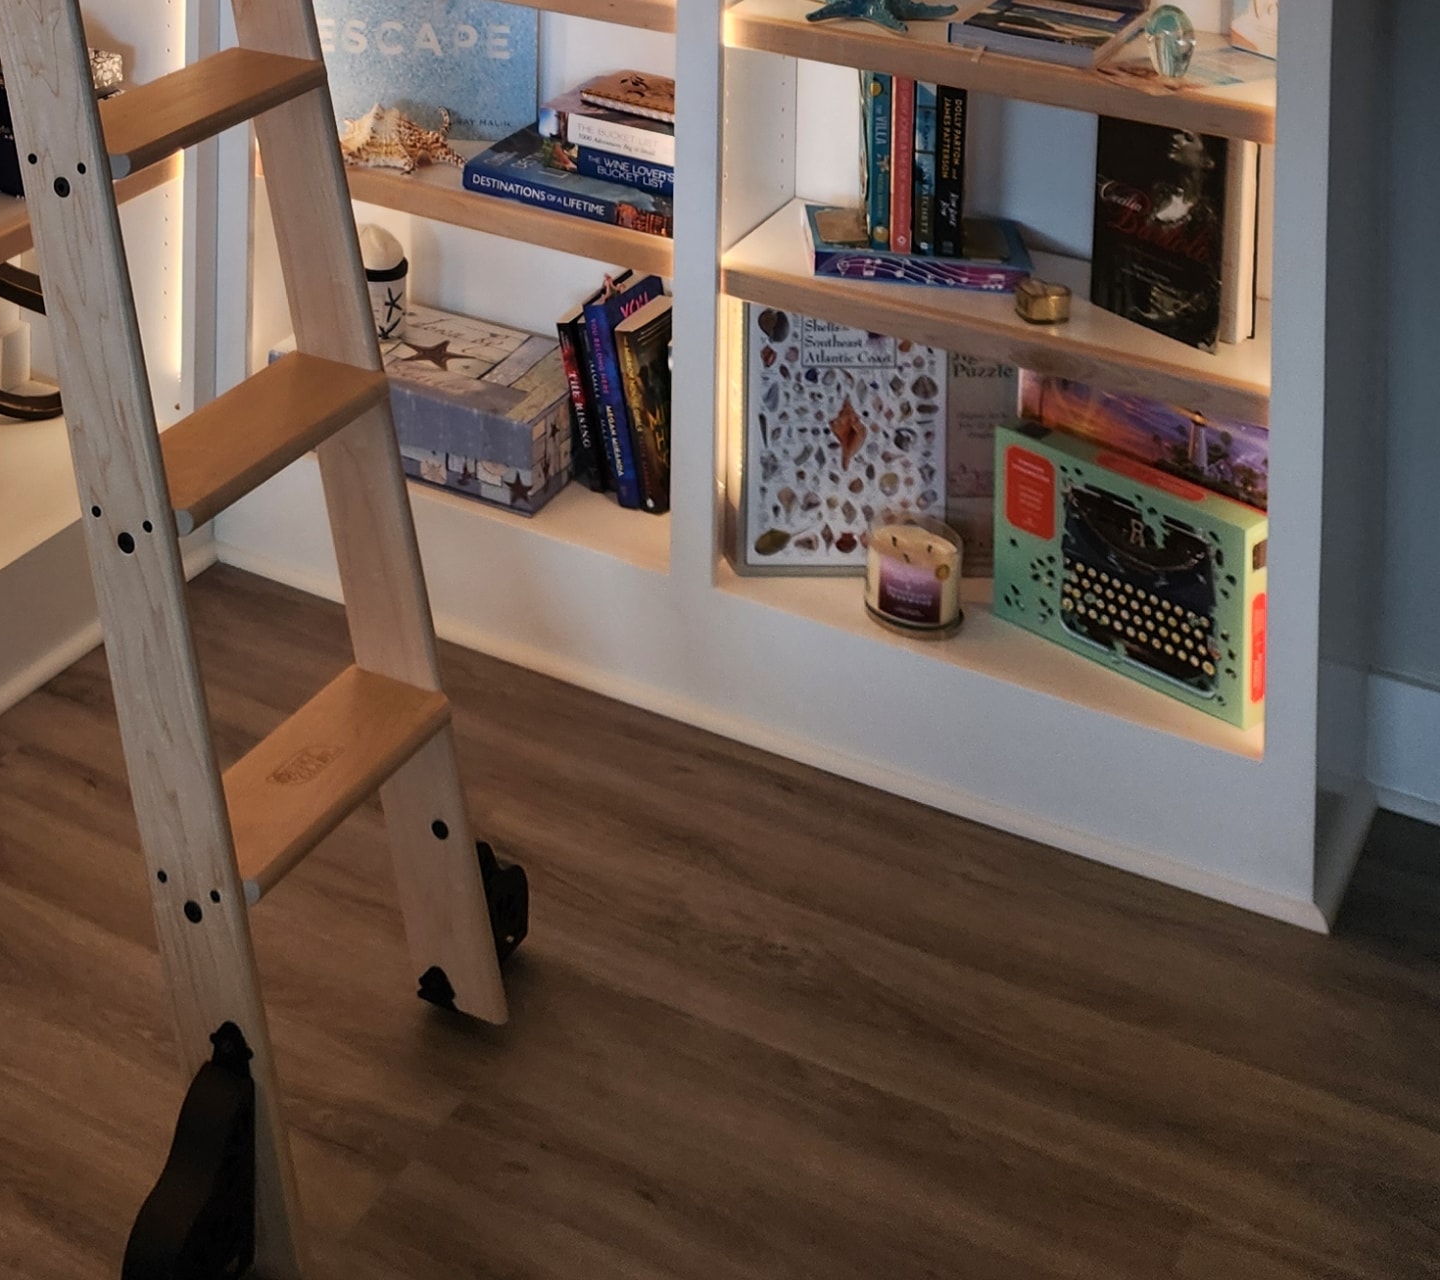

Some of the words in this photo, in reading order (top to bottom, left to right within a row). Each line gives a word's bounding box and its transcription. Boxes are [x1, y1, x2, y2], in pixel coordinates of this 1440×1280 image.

[320, 16, 512, 61] ESCAPE
[875, 116, 888, 144] VILLA
[603, 155, 630, 171] WINE
[597, 165, 639, 186] BUCKET
[472, 173, 546, 201] DESTINATIONS
[563, 197, 605, 217] LIFETIME
[953, 364, 1014, 379] Puzzle
